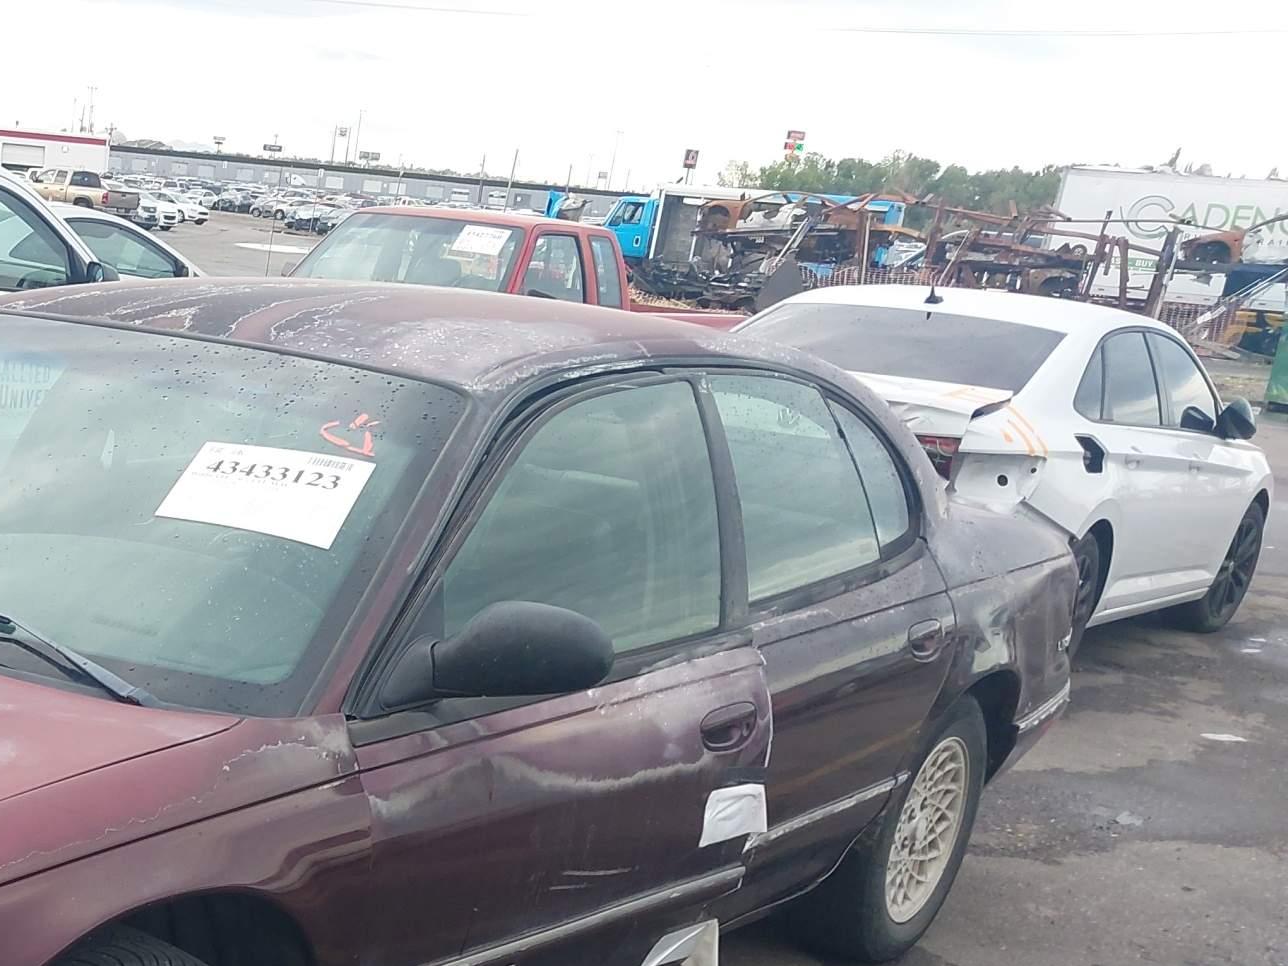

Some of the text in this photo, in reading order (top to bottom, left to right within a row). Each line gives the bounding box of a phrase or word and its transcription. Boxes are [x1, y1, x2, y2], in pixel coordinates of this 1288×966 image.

[1134, 259, 1154, 268] BUY
[0, 359, 51, 384] ALLIED
[206, 459, 342, 491] 43433123
